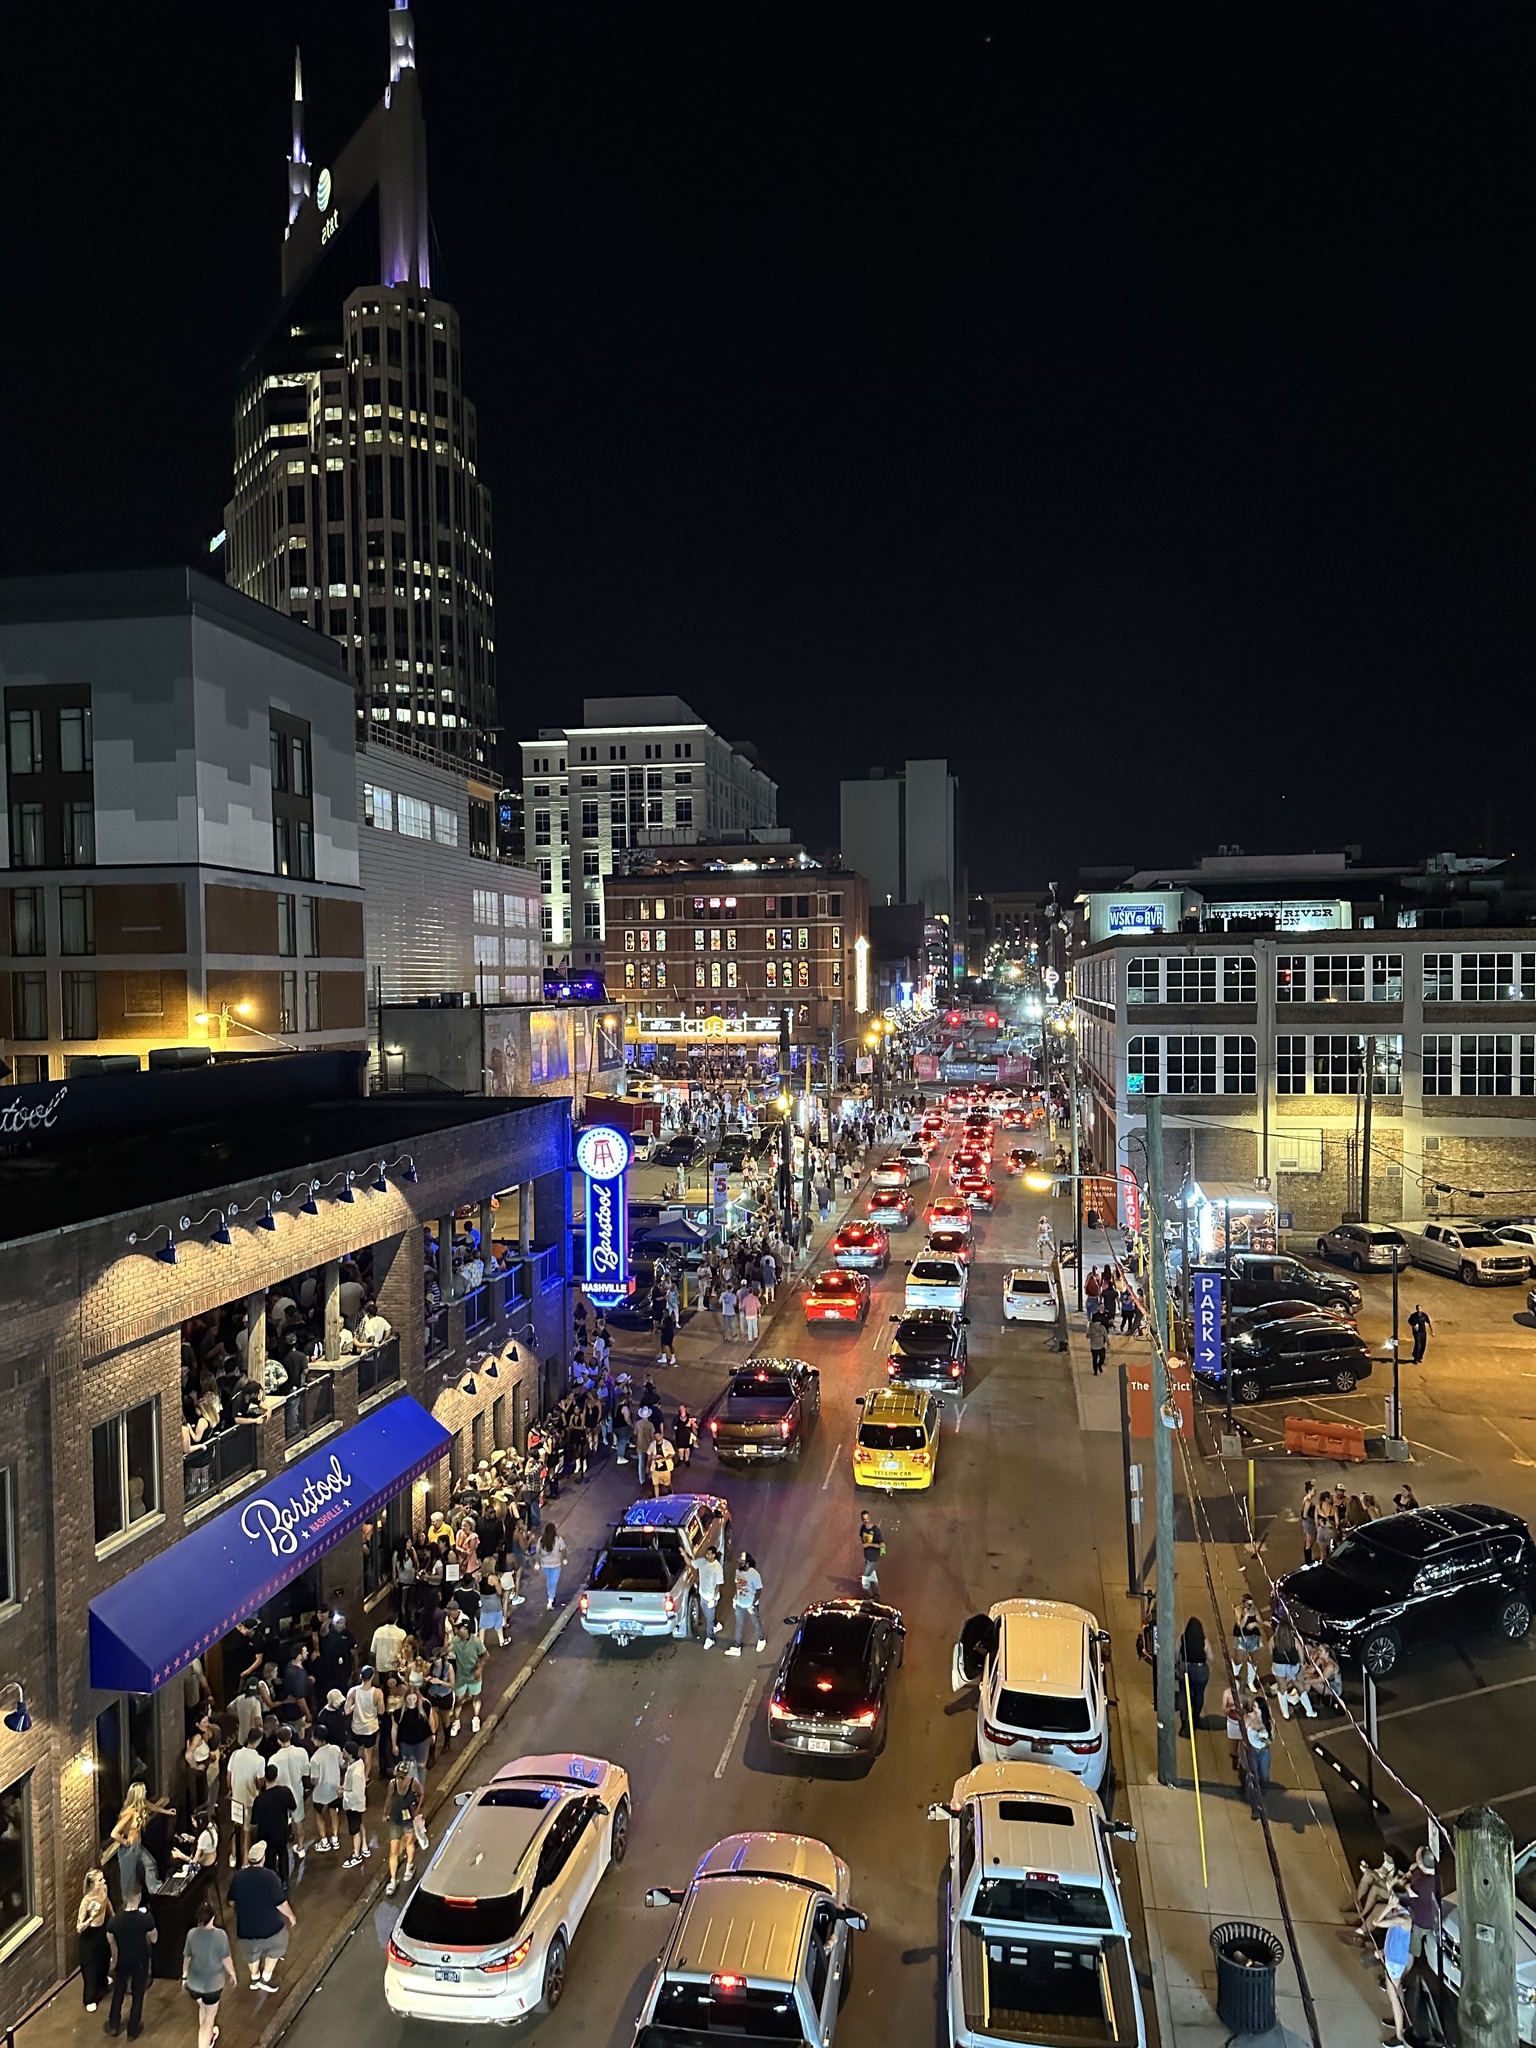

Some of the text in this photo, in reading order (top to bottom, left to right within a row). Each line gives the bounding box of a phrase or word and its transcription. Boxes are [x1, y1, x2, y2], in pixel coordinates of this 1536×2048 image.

[1110, 911, 1163, 926] WSKY RVR
[1212, 908, 1333, 920] WHISKEY RIVER
[684, 1021, 744, 1034] CHIEF'S
[592, 1183, 619, 1273] Barstool
[581, 1282, 628, 1293] NASHVILLE
[1200, 1278, 1215, 1342] PARK
[1131, 1381, 1150, 1390] The
[241, 1454, 352, 1557] Barstool
[308, 1504, 344, 1533] NASHVILLE
